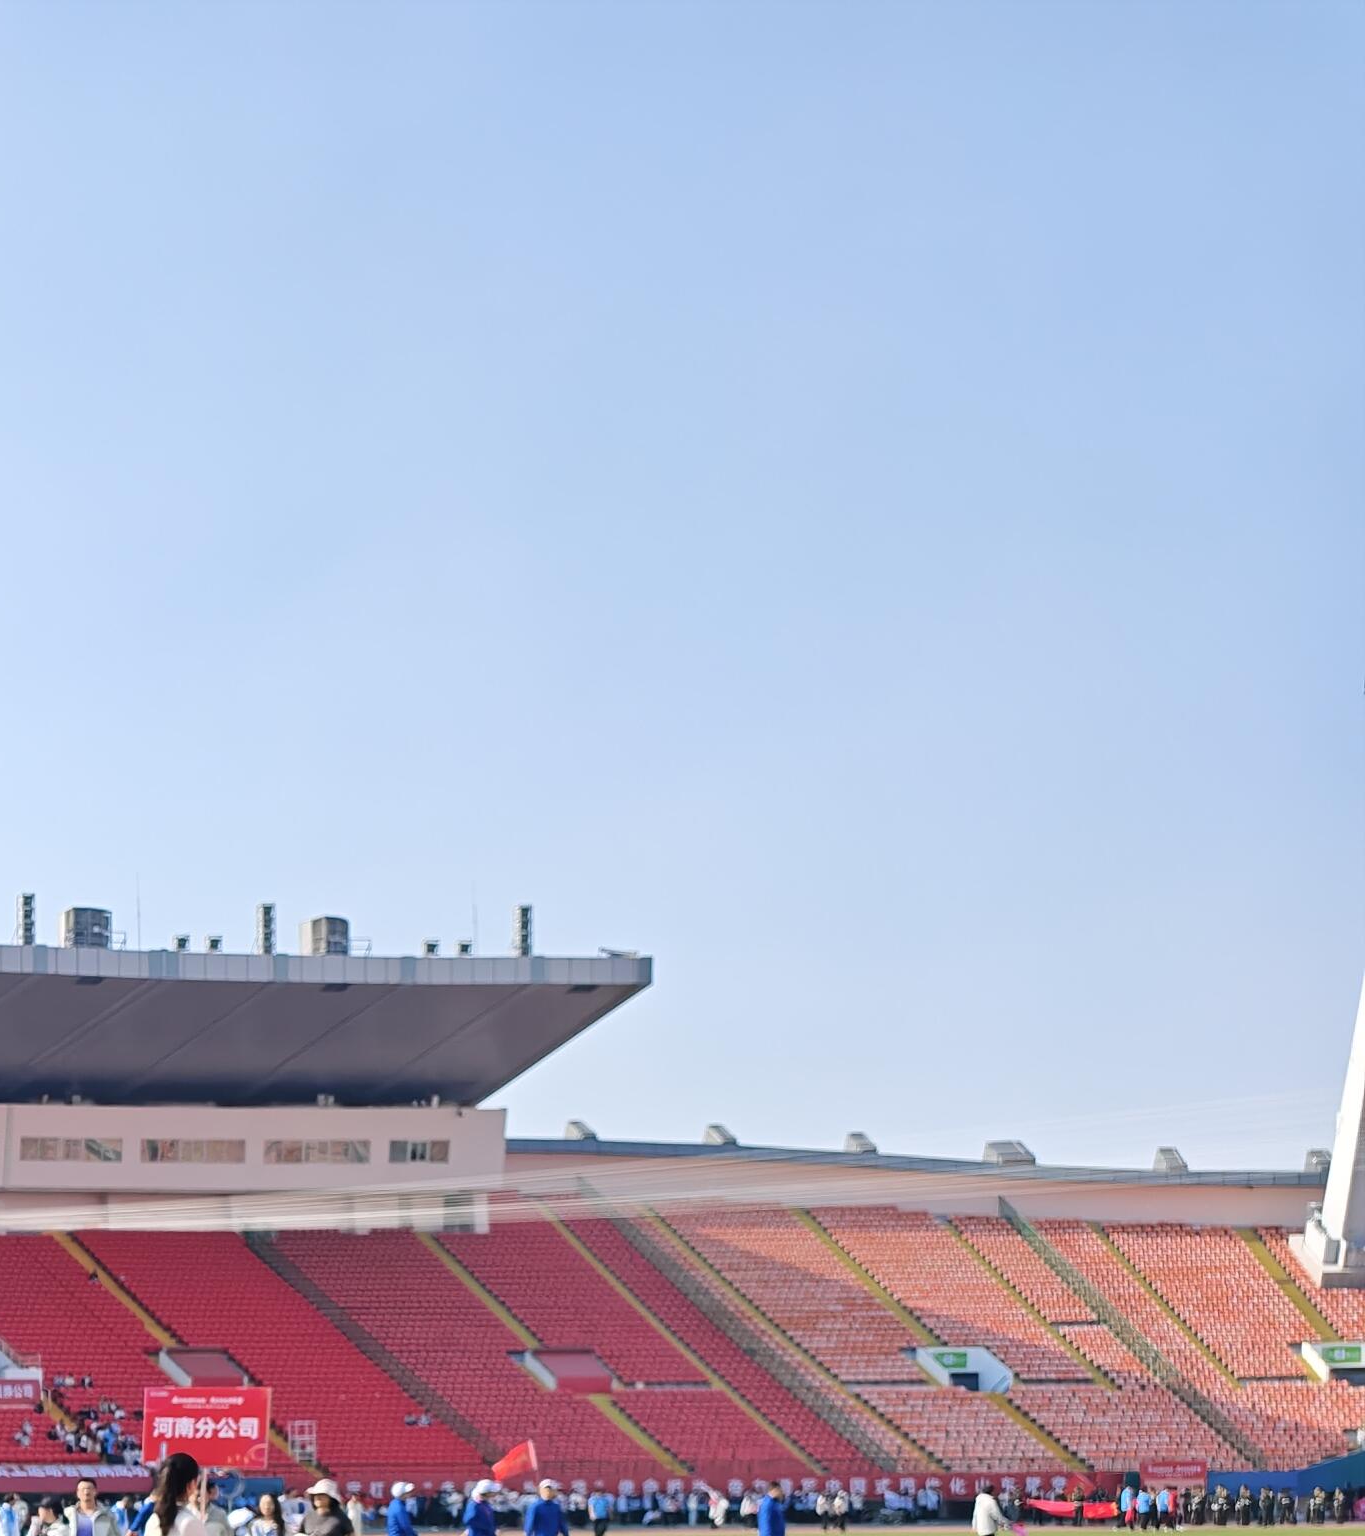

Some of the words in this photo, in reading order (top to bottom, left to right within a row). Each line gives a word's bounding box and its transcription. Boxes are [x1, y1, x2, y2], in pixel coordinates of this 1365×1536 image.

[153, 1416, 259, 1439] 河南分公司
